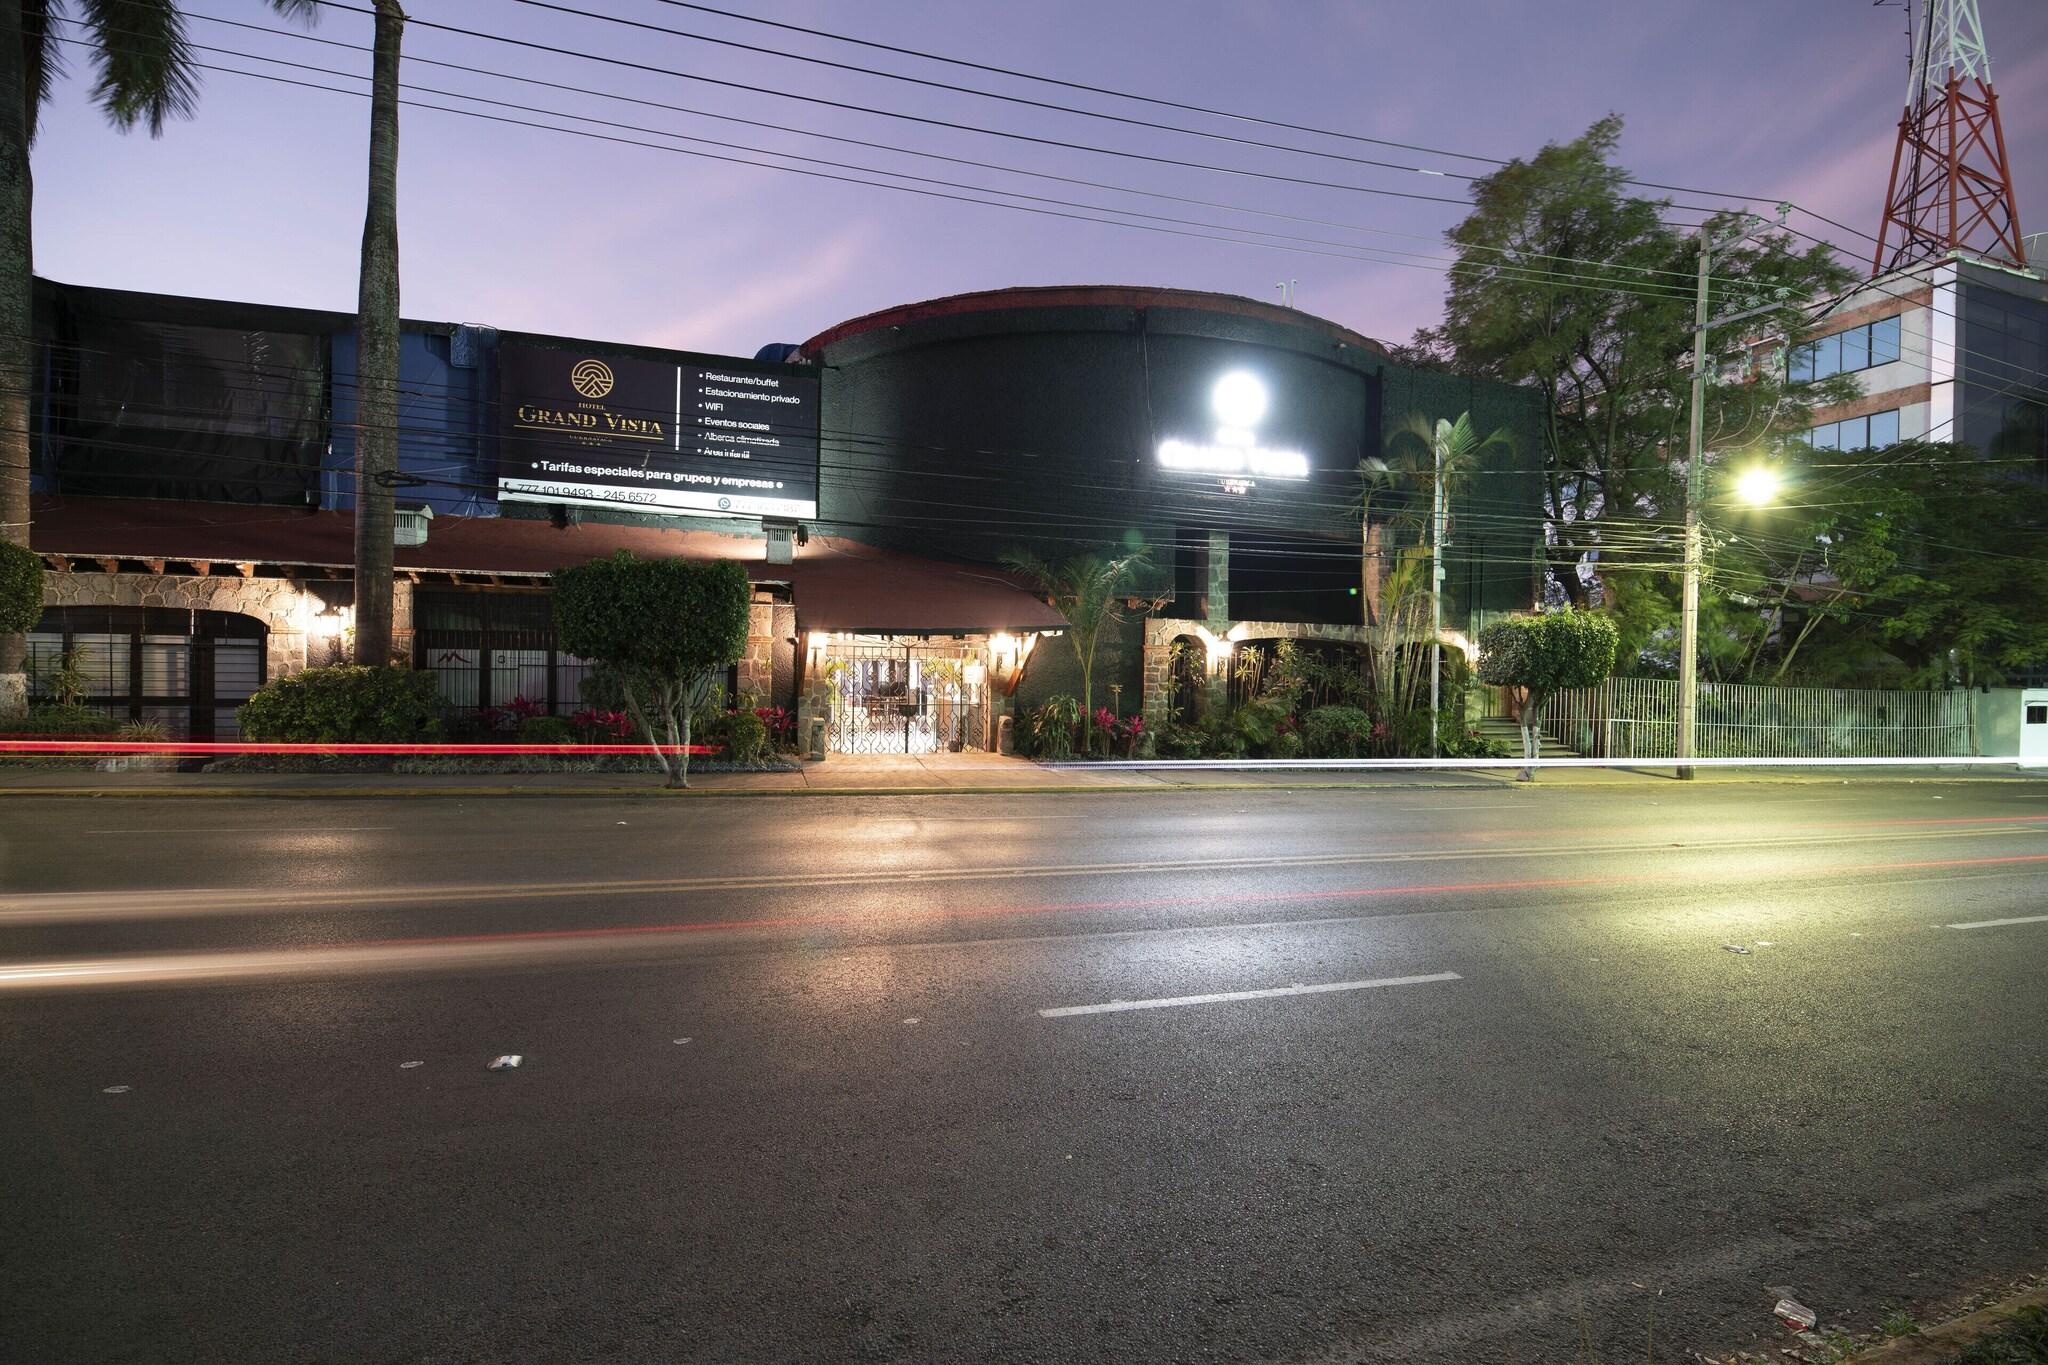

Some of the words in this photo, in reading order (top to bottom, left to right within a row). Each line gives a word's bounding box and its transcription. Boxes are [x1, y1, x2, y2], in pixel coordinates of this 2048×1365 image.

[705, 372, 779, 388] Restaurante/buffet
[705, 387, 770, 401] Estacionamiento
[771, 394, 800, 405] privado
[578, 402, 606, 411] HOTEL
[705, 402, 724, 412] WIFI
[518, 405, 597, 428] GRAND
[604, 413, 664, 435] VISTA
[705, 417, 737, 428] Eventos
[738, 421, 770, 431] sociales
[704, 432, 735, 443] Alberca
[541, 460, 582, 473] Tarifas
[584, 465, 645, 479] especiales
[646, 470, 671, 480] para
[673, 473, 711, 484] grupos
[713, 477, 721, 486] y
[722, 477, 775, 489] empresas
[518, 483, 539, 493] 777
[542, 486, 560, 495] 101
[562, 487, 593, 498] 9493
[603, 490, 626, 501] 245
[628, 491, 657, 503] 6572
